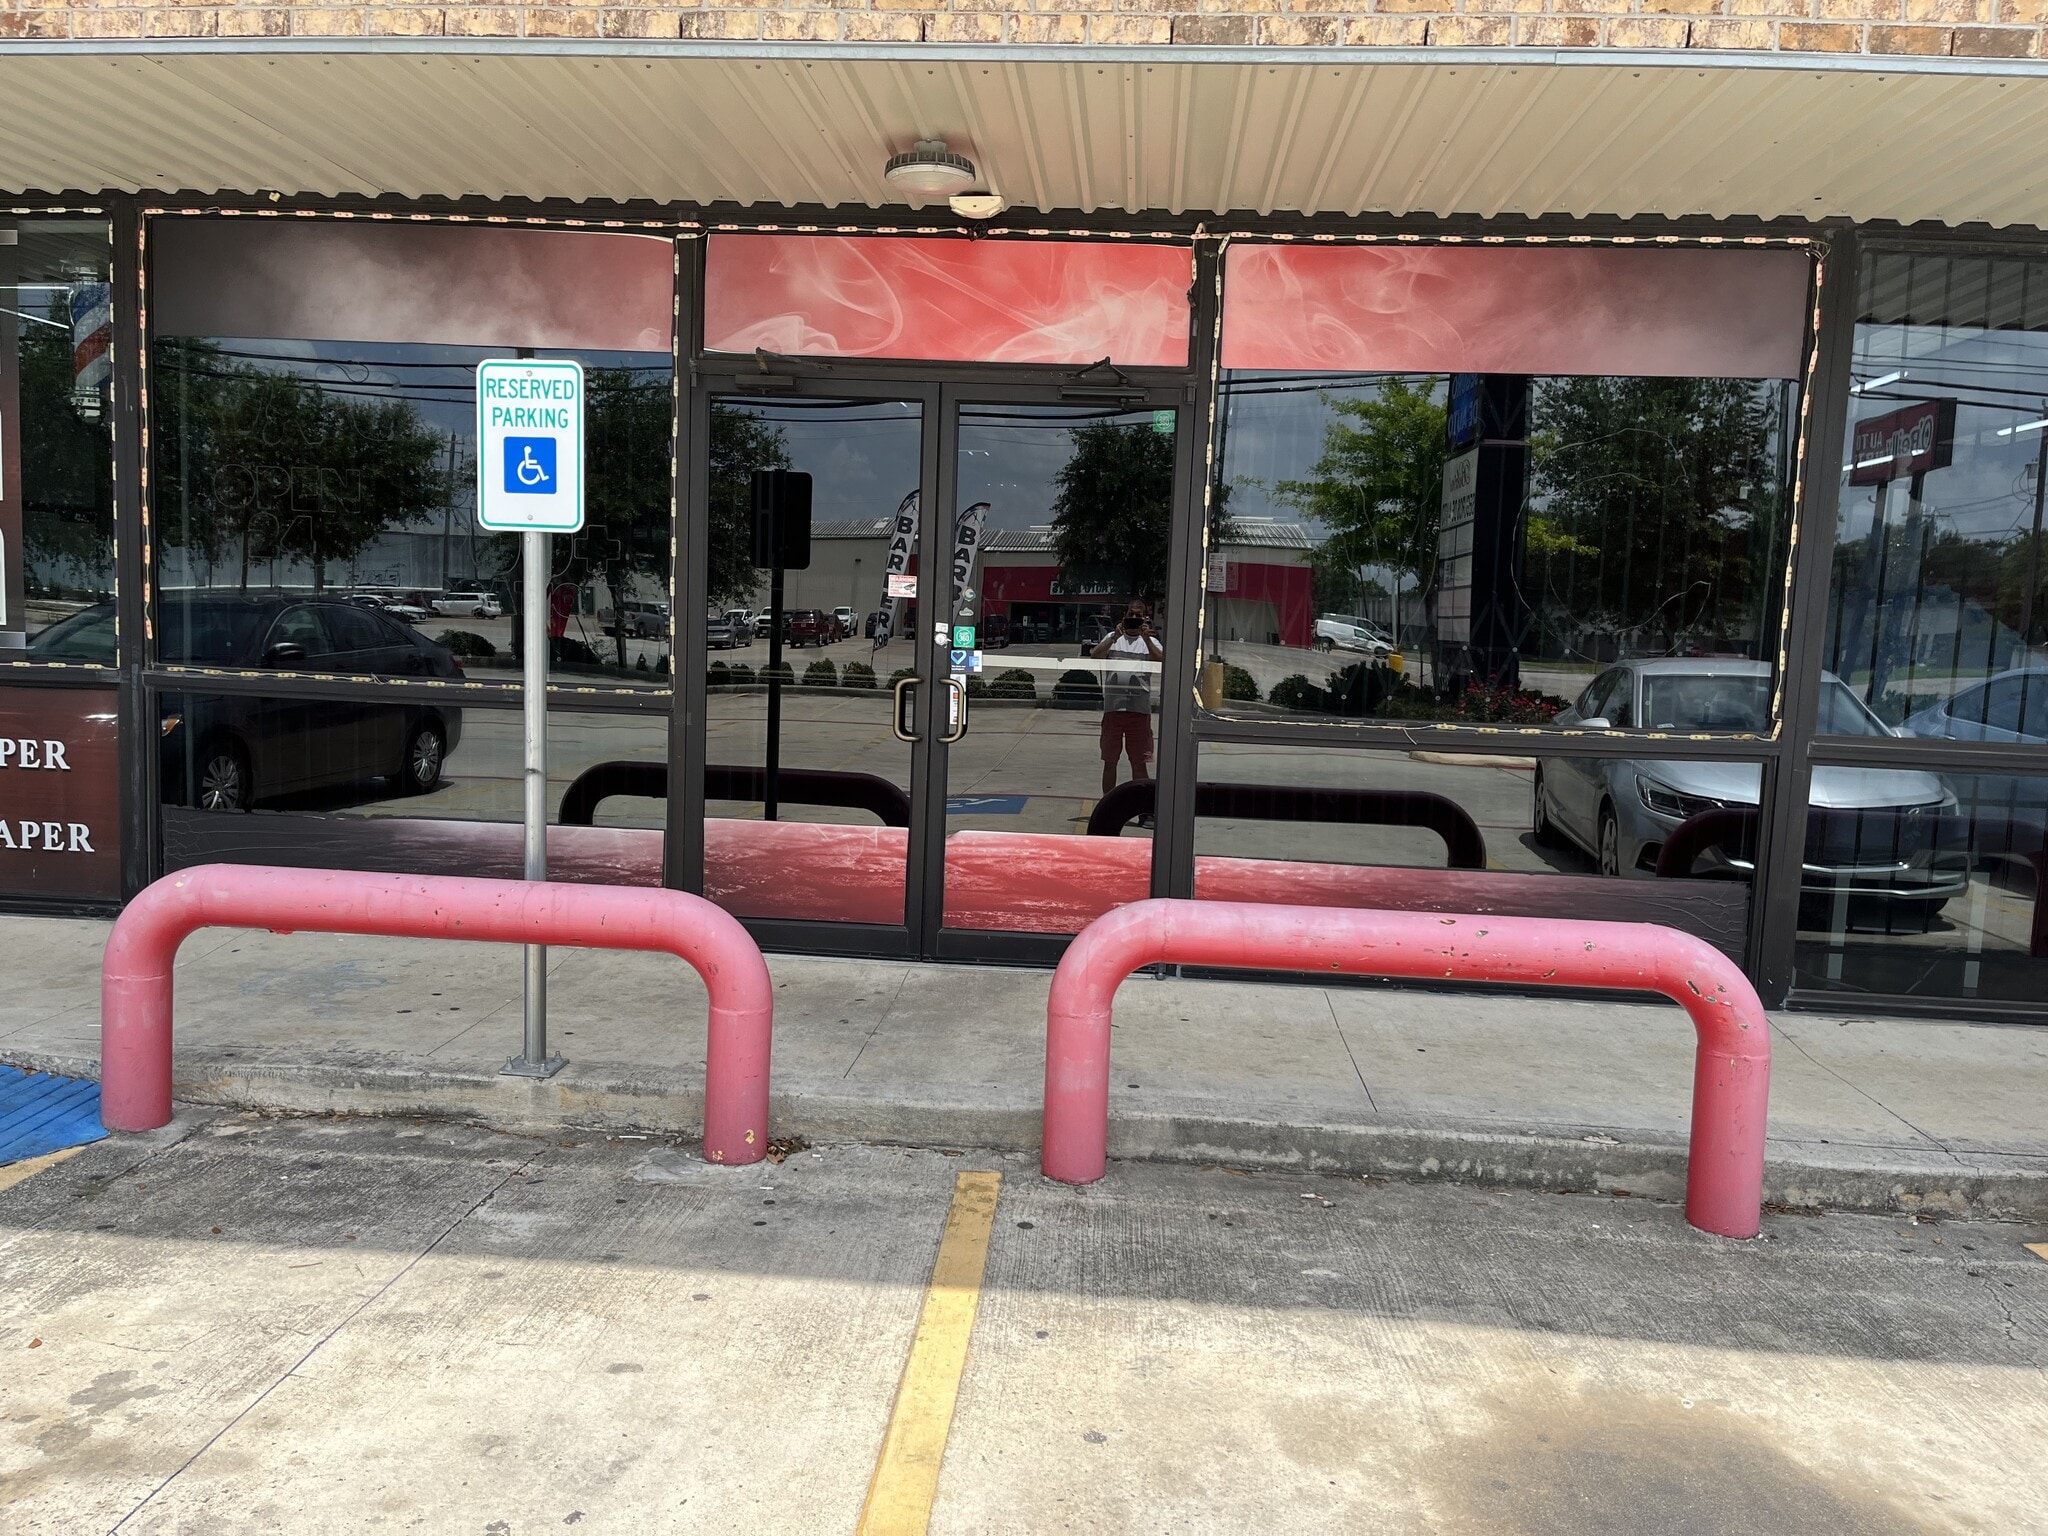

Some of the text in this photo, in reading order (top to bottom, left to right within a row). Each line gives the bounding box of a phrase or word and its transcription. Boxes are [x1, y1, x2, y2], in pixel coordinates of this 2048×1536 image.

[486, 378, 575, 400] RESERVED
[492, 407, 569, 429] PARKING
[876, 516, 914, 629] BARER
